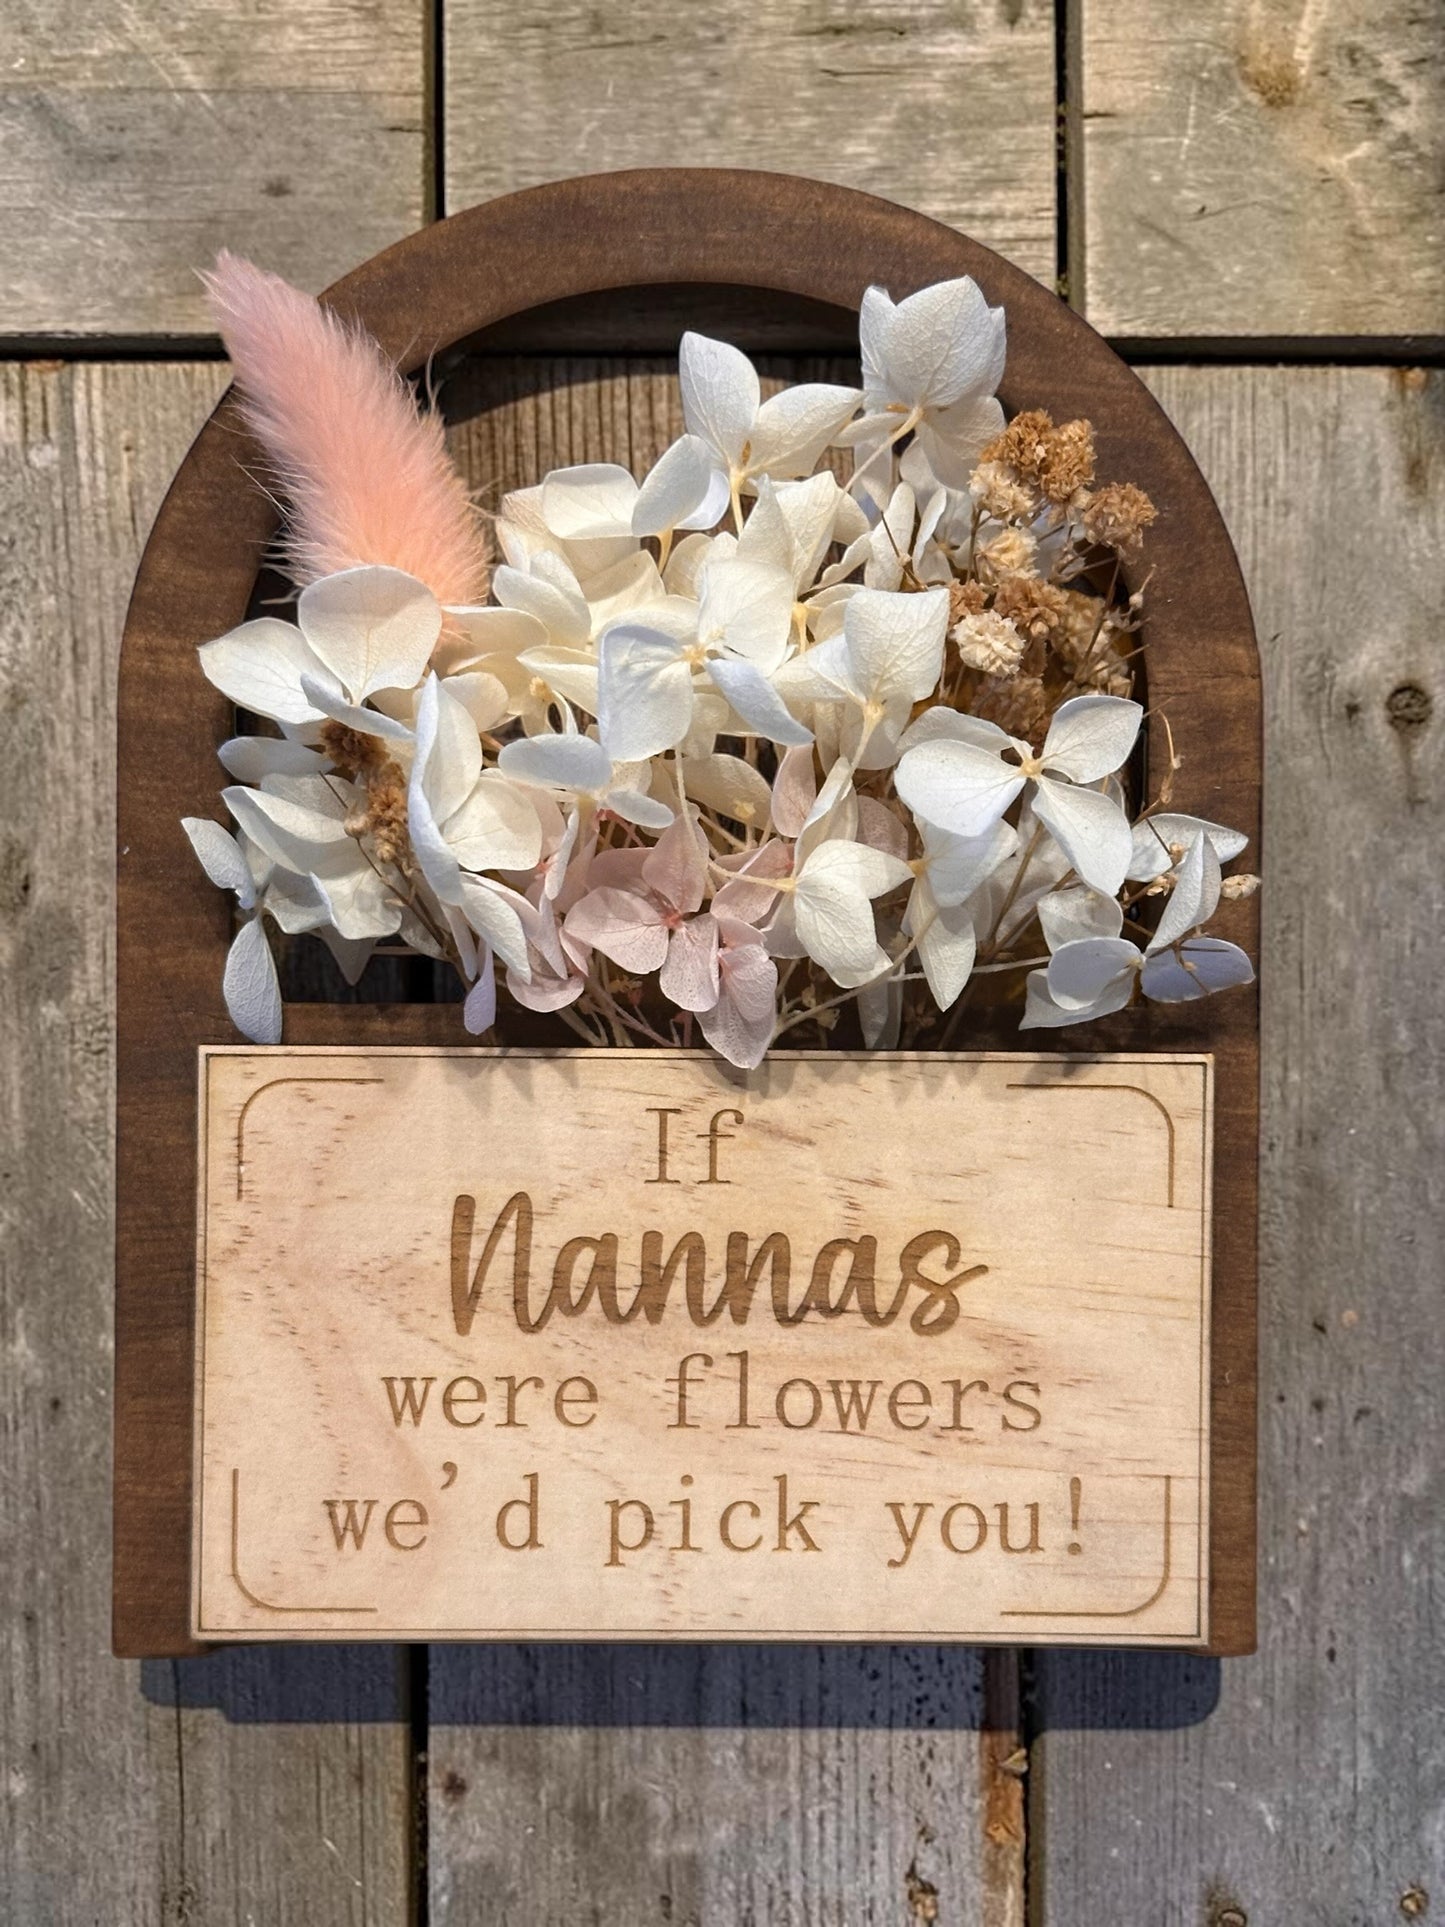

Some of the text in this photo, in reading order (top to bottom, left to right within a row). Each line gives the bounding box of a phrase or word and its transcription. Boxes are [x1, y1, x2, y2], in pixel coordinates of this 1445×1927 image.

[644, 1107, 745, 1185] If
[450, 1193, 989, 1337] Nannas
[381, 1350, 1042, 1436] were flowers
[322, 1461, 1085, 1569] we’d pick you!
